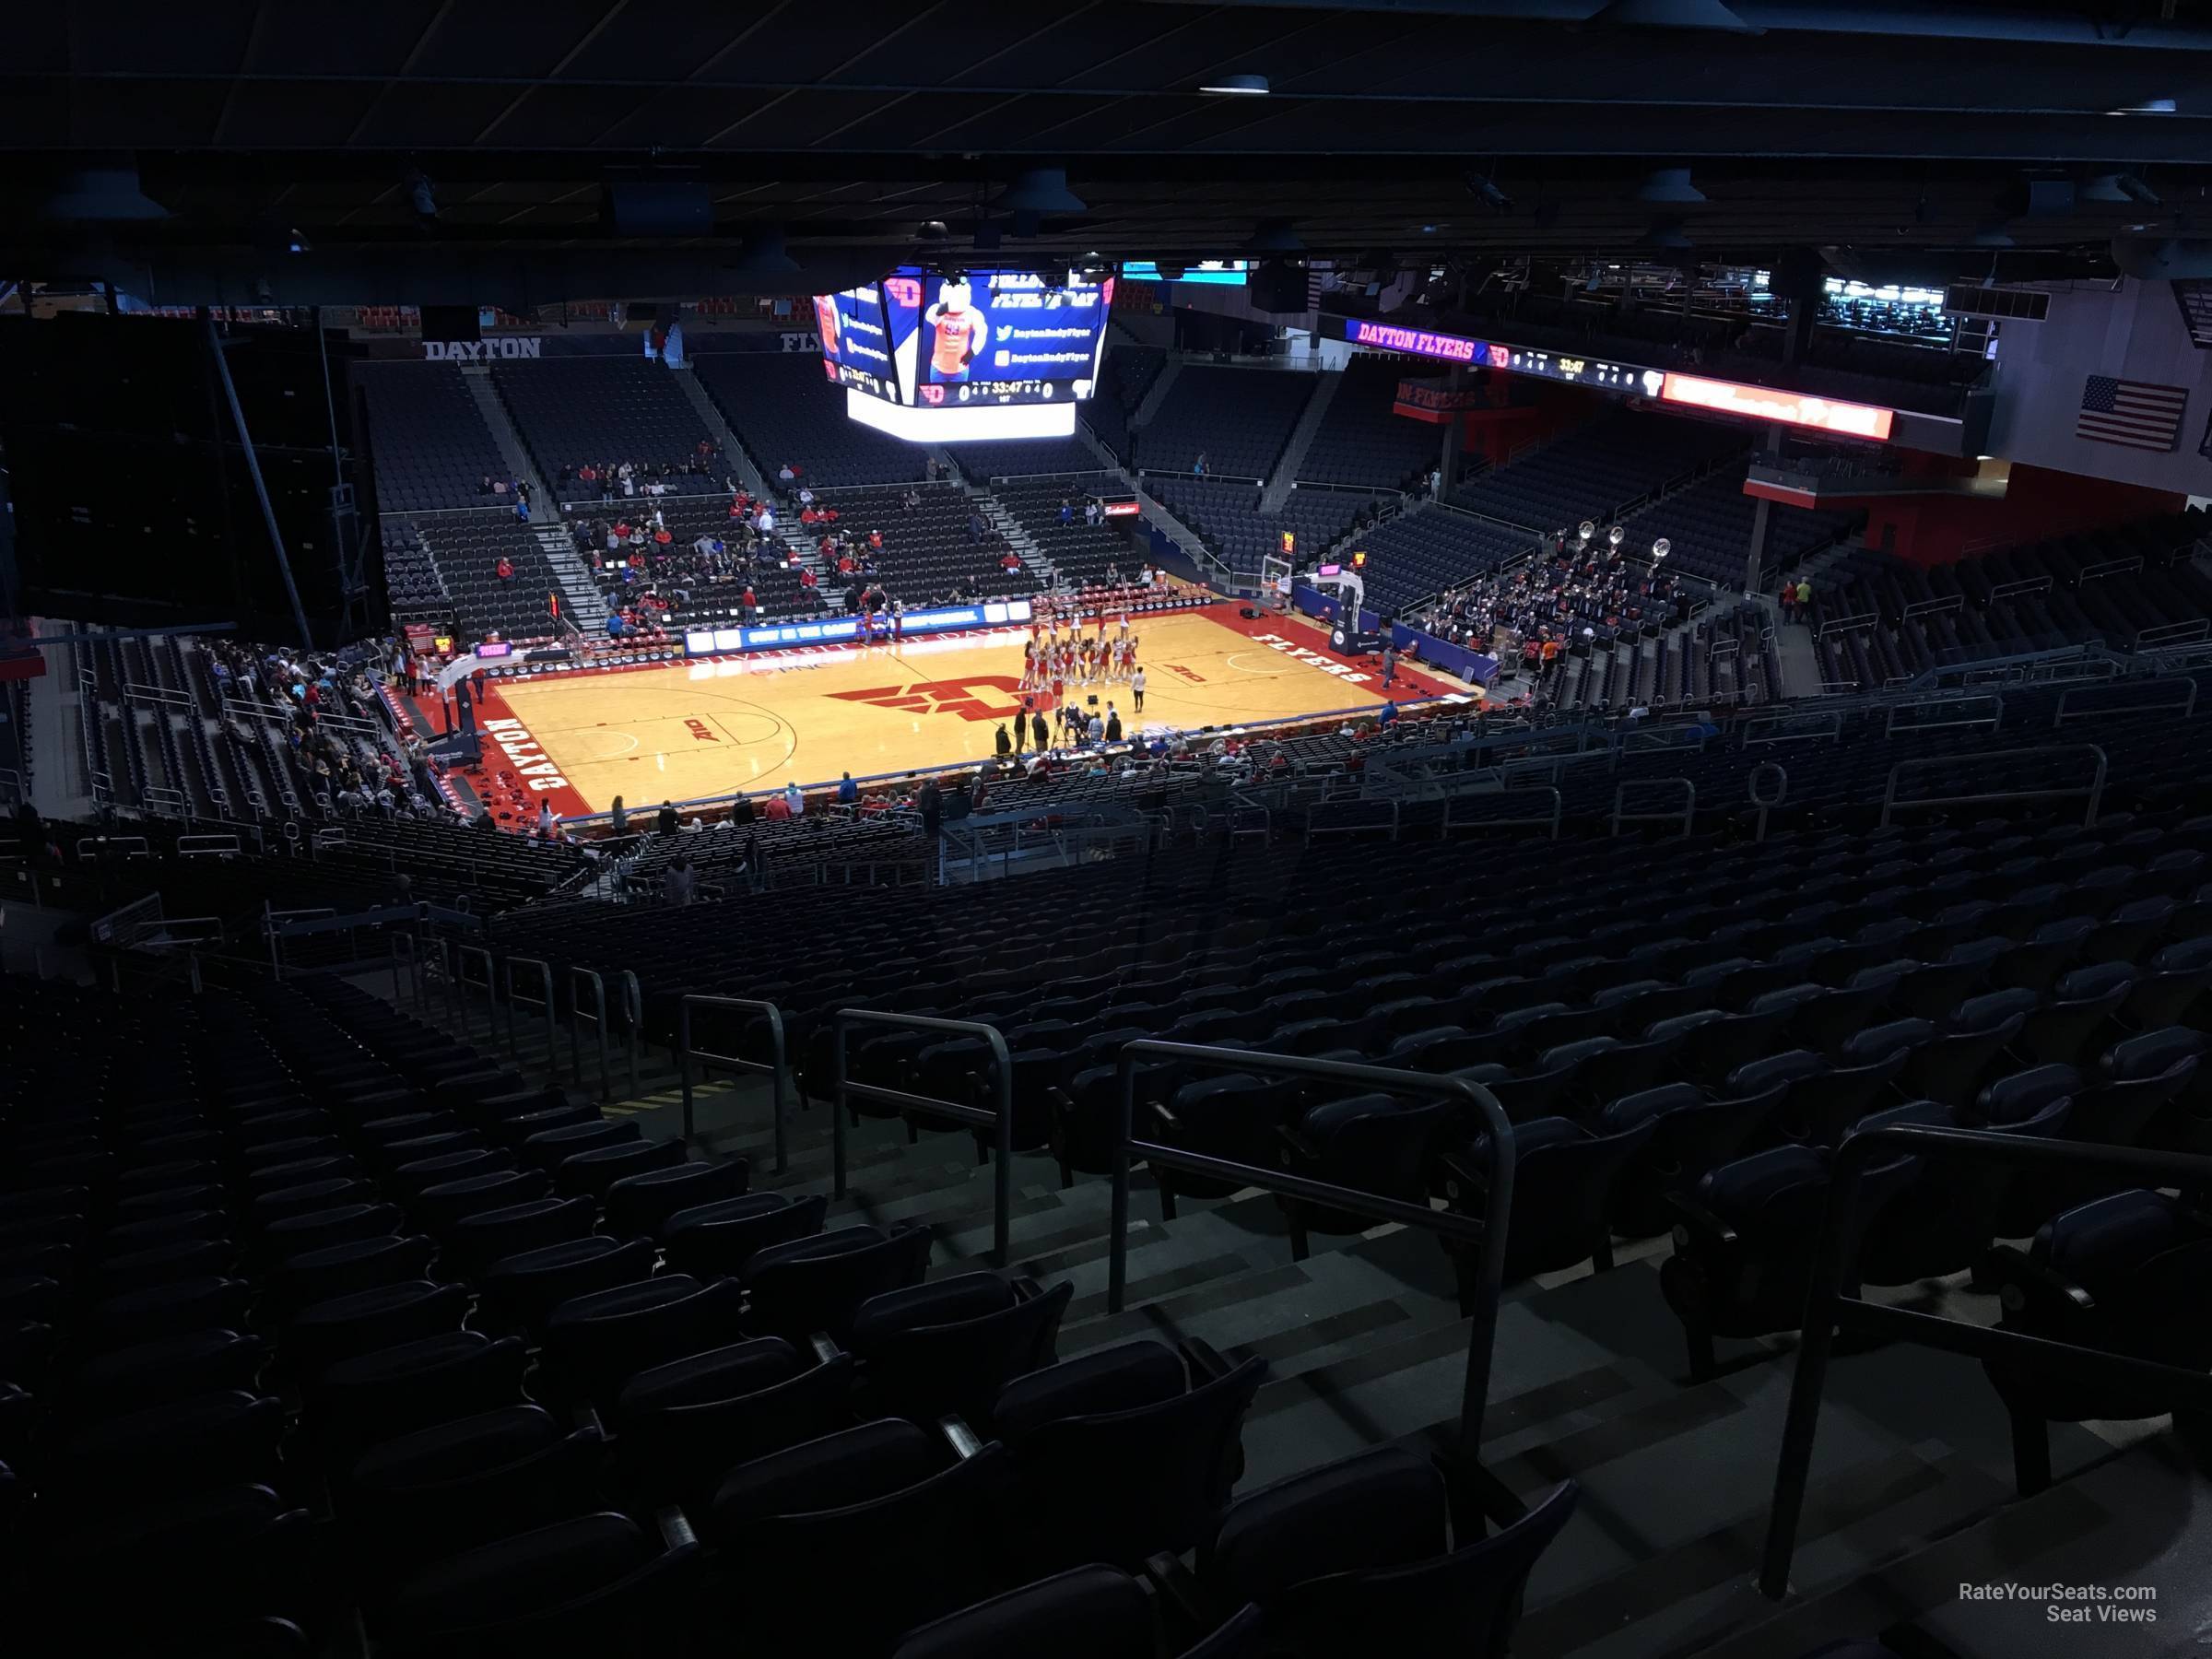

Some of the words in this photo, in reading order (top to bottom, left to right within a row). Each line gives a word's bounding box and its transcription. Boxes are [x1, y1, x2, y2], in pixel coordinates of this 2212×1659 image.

[422, 337, 541, 360] DAYTON
[1358, 324, 1417, 349] DAYTON
[1416, 334, 1475, 359] FLYERS
[959, 385, 970, 401] 0
[972, 386, 978, 395] 4
[992, 382, 1022, 394] 33:47
[1034, 382, 1040, 393] 4
[1042, 382, 1053, 398] 0
[1252, 634, 1372, 683] FLYERS
[778, 662, 833, 674] PNC
[483, 718, 569, 791] DAYTON
